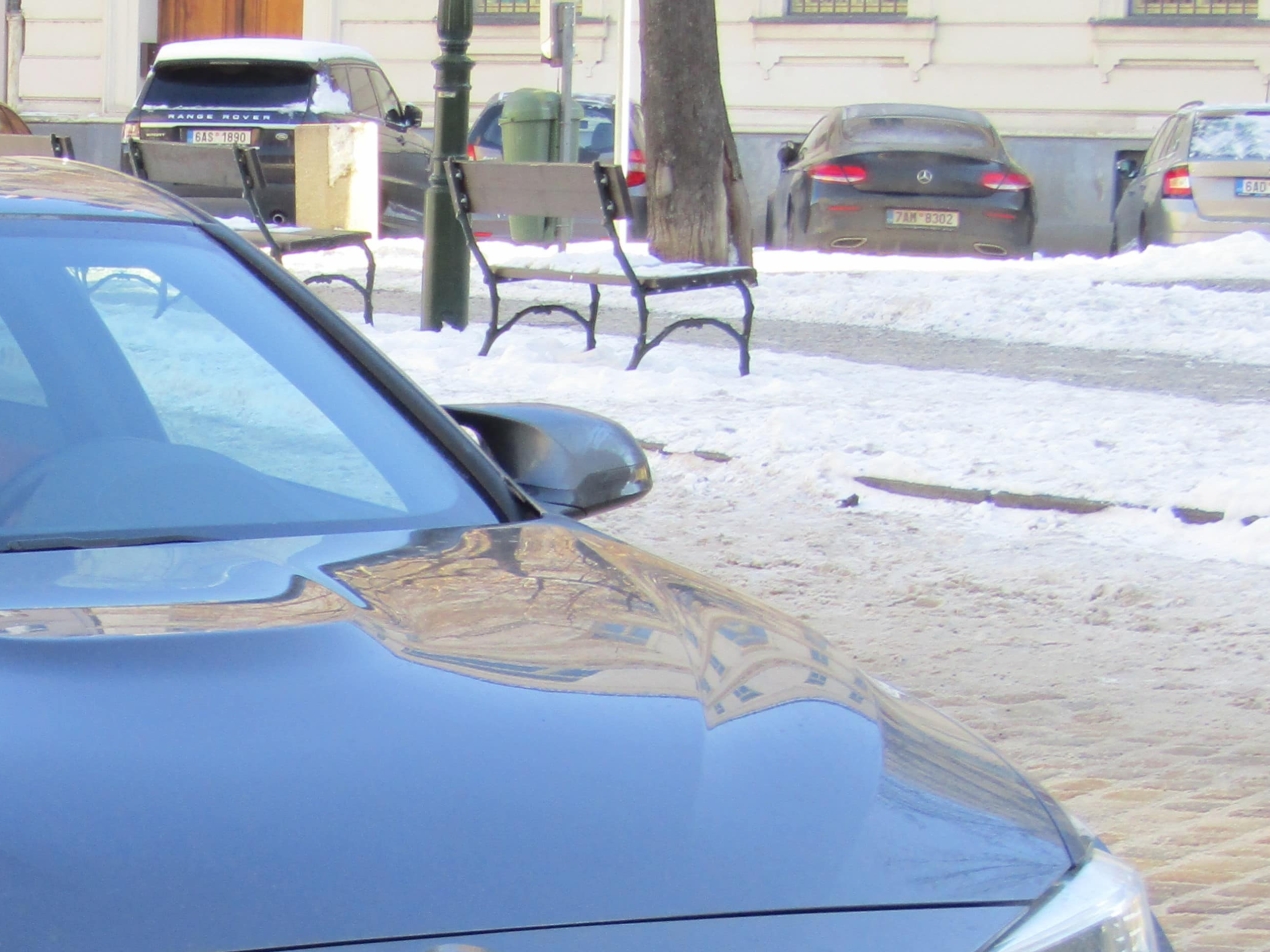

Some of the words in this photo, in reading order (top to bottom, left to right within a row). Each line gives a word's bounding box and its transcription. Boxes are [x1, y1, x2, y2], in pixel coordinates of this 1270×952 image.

[195, 132, 214, 143] 6AS
[222, 132, 246, 143] 1890
[895, 211, 917, 223] 7AM
[925, 213, 954, 225] 8302
